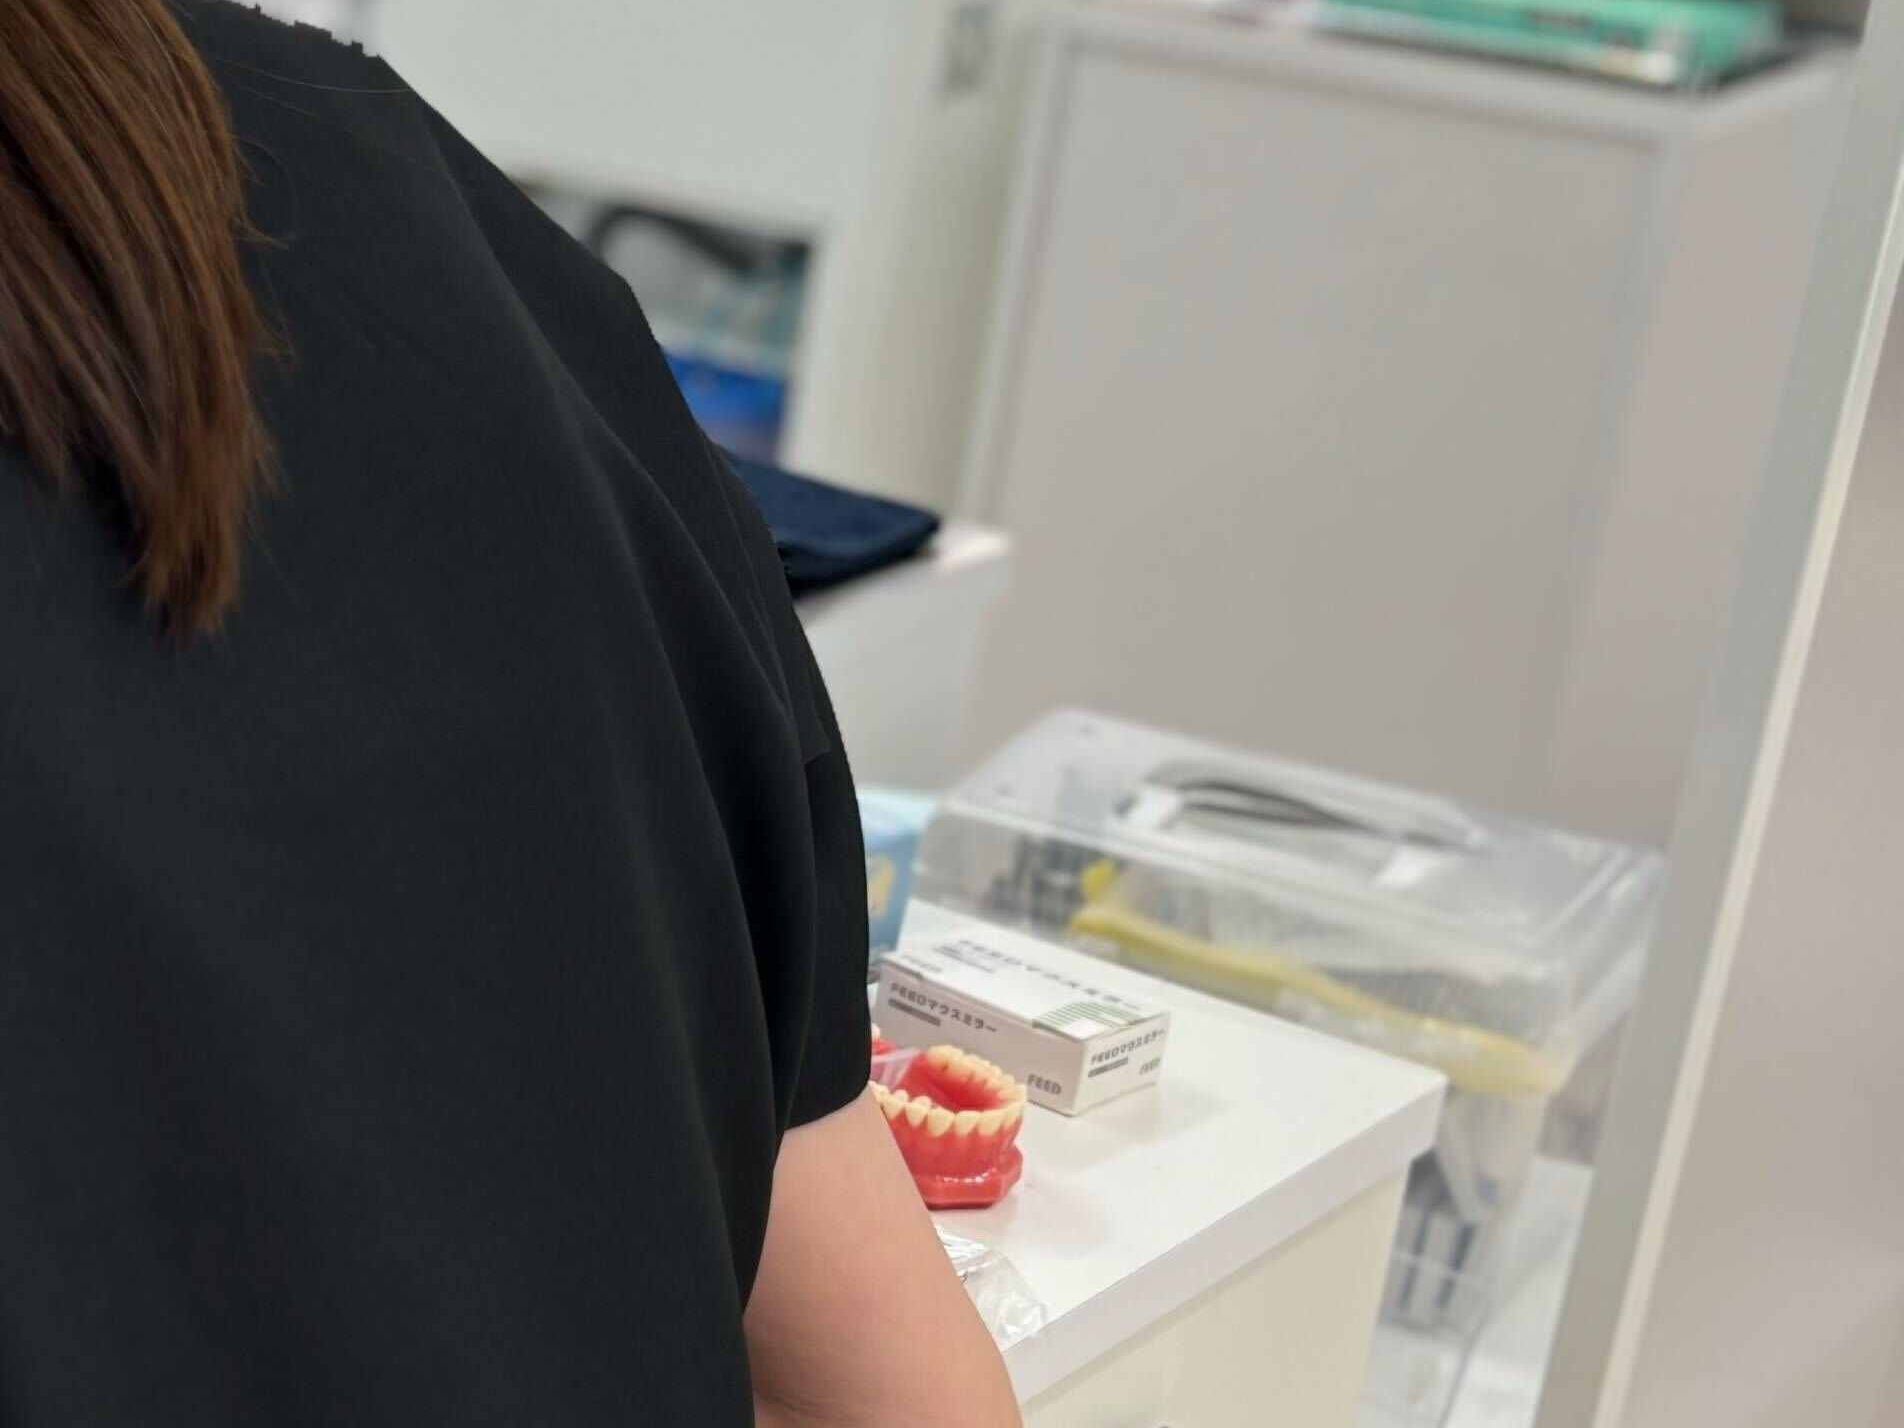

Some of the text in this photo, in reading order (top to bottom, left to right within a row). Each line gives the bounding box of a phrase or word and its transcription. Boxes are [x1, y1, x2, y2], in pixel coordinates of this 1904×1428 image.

[890, 982, 997, 1032] FEEDマウスミラー
[1028, 1073, 1061, 1095] FEED
